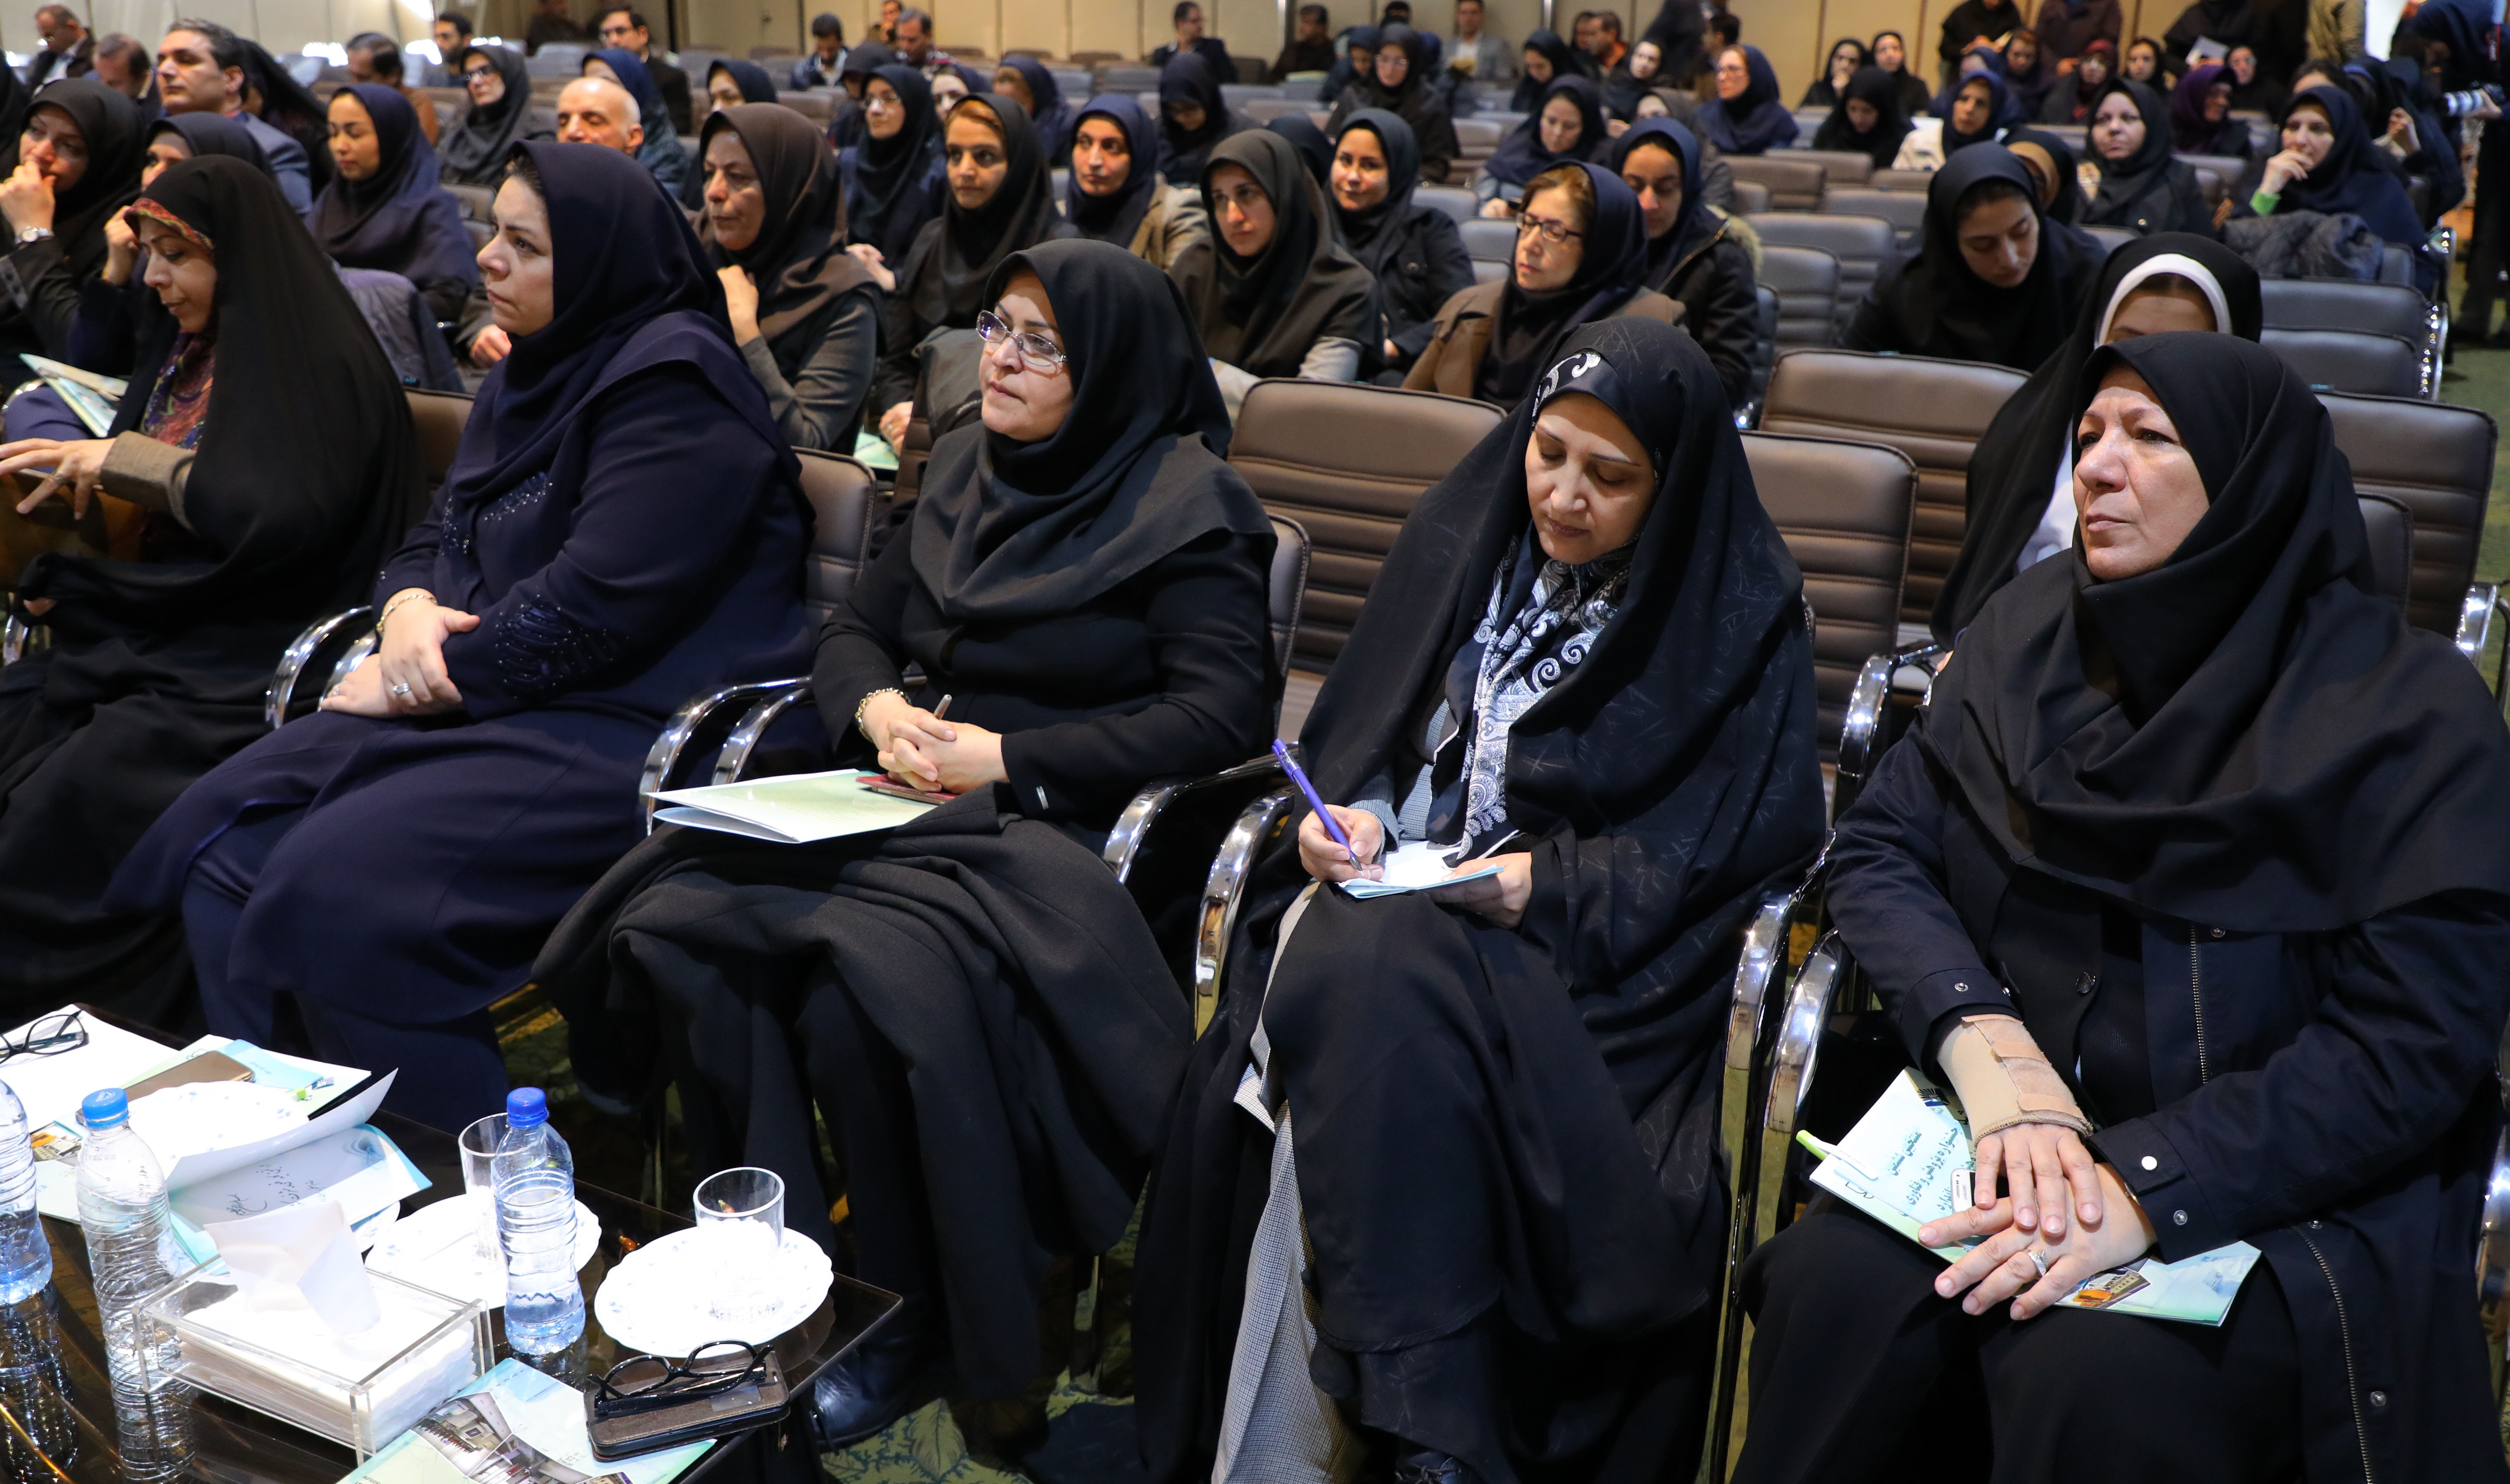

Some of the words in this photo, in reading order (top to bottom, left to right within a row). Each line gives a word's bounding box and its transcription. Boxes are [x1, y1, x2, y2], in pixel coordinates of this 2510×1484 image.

[1903, 1132, 1922, 1157] منتخبین
[1937, 1127, 1962, 1156] جشنواره
[1888, 1153, 1905, 1176] ششمین
[1921, 1155, 1946, 1180] پژوهش
[1906, 1180, 1923, 1205] فناوری
